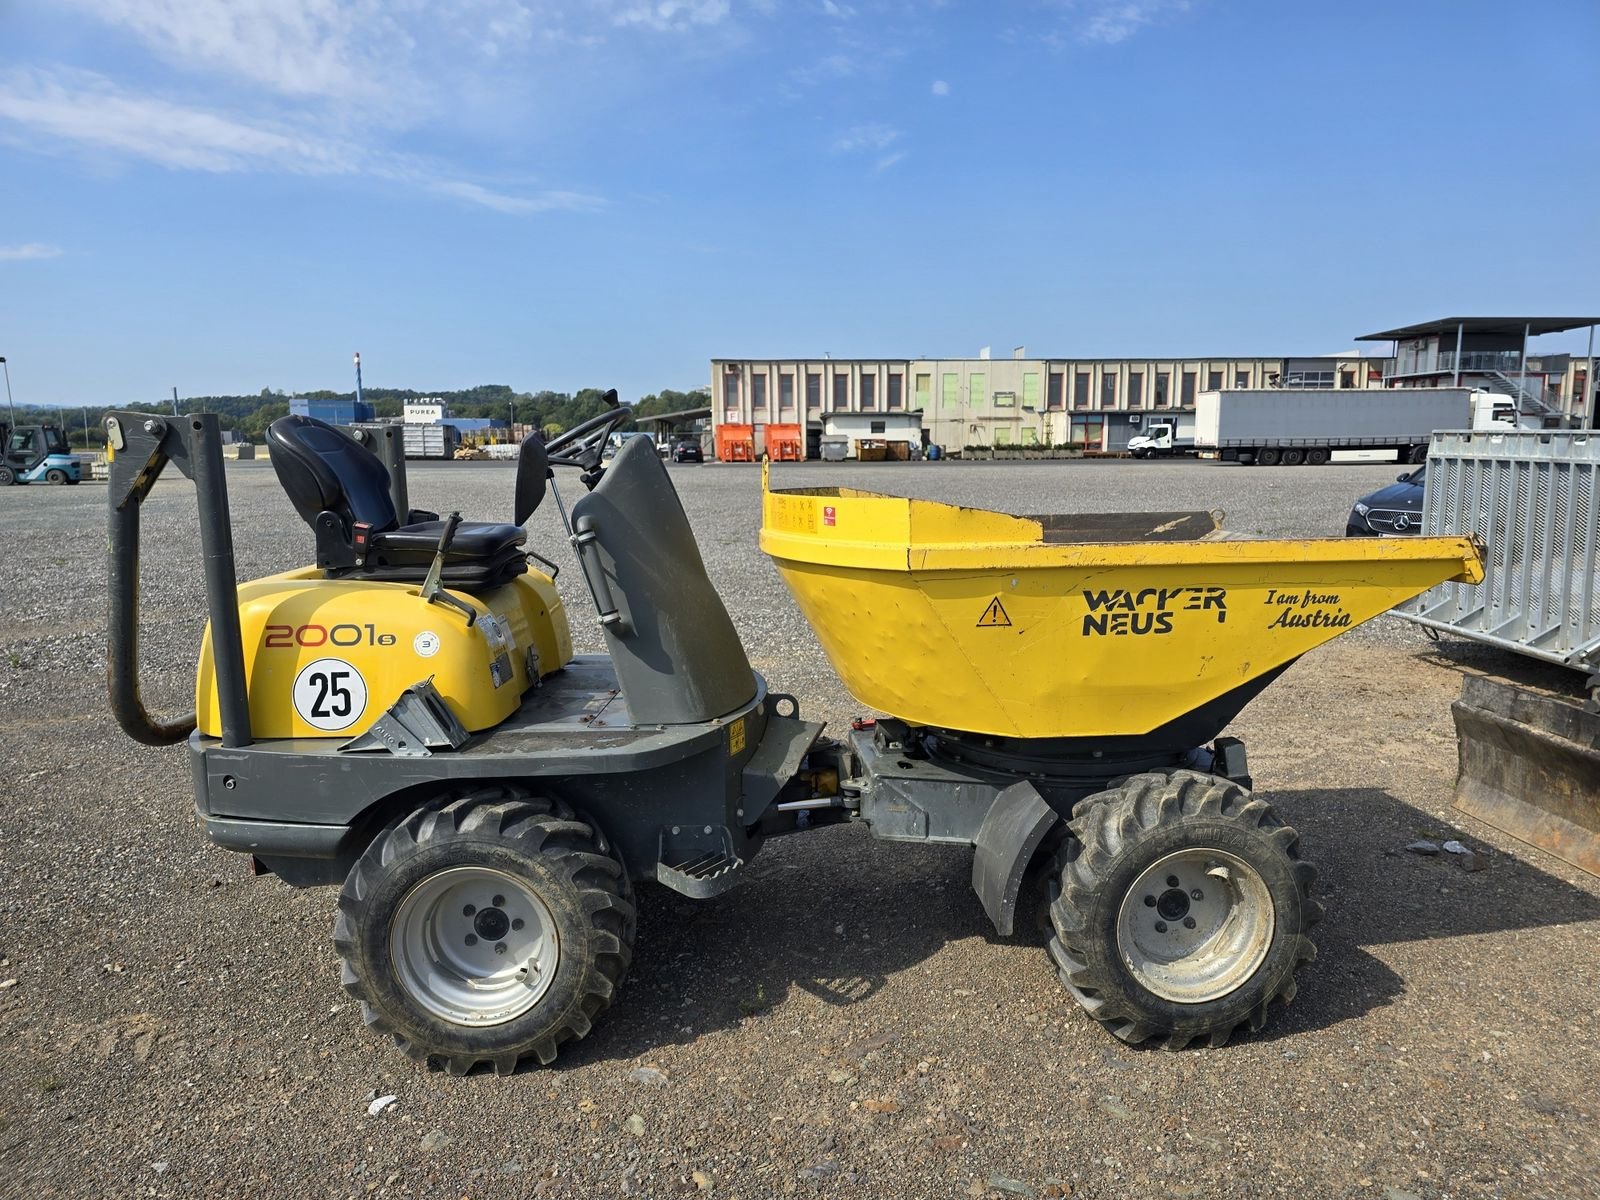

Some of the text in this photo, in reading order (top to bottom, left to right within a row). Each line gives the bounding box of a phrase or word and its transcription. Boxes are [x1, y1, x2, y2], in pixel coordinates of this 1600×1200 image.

[1264, 589, 1342, 609] I am from
[1267, 606, 1353, 630] Austria
[308, 671, 352, 718] 25
